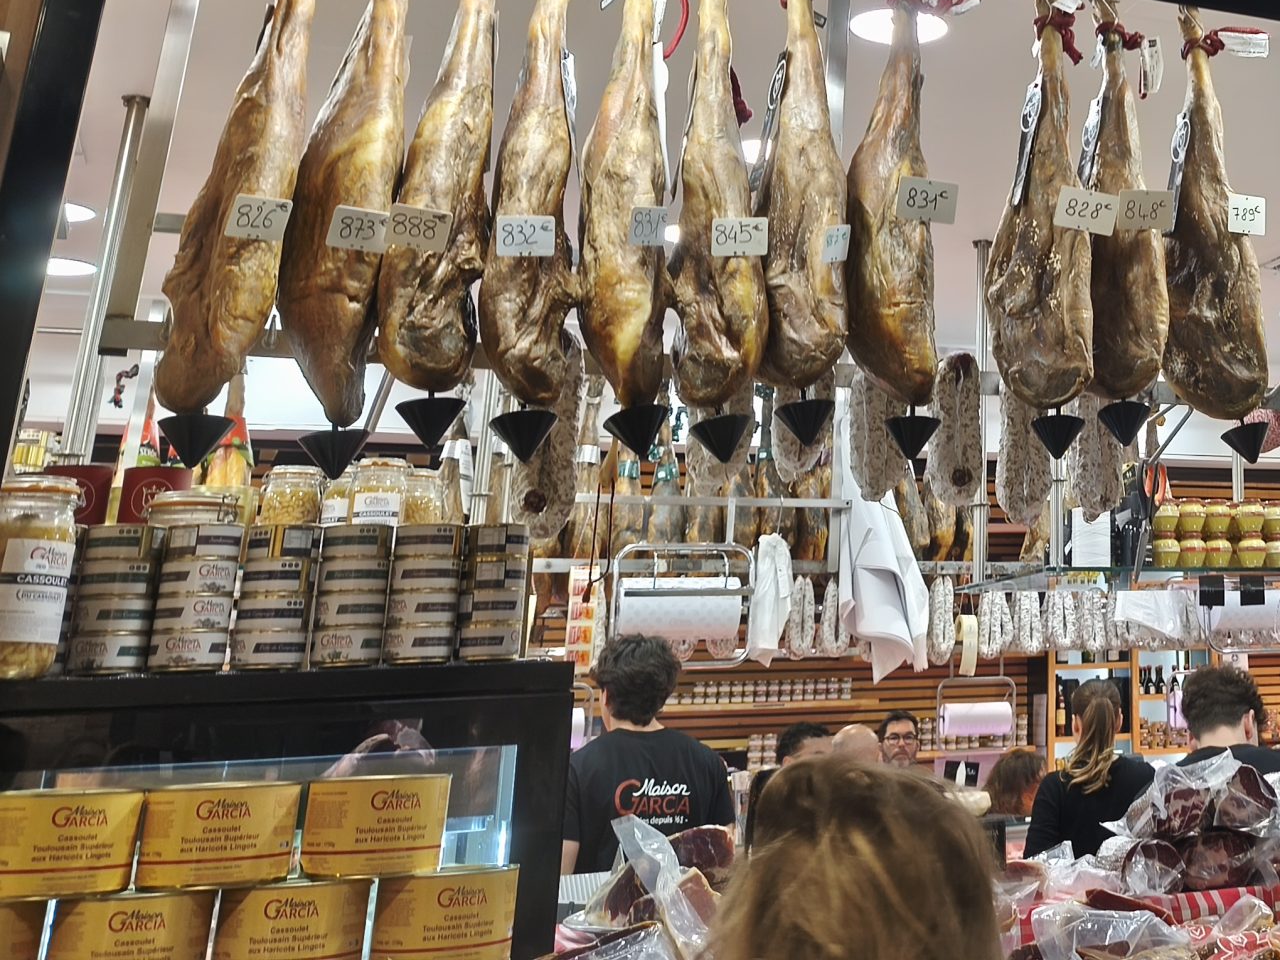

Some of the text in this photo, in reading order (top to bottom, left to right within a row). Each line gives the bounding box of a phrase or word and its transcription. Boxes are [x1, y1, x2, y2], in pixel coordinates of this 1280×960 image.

[16, 574, 68, 586] CASSOULET
[632, 778, 690, 796] Maison
[371, 790, 421, 811] GARCIA
[52, 806, 108, 828] GARCIA
[196, 800, 251, 820] GARCIA
[377, 816, 413, 824] Cassoulet
[650, 815, 673, 825] depuis
[203, 825, 241, 834] Cassoulet
[58, 834, 98, 842] Cassoulet
[437, 887, 488, 908] GARCIA
[264, 899, 319, 920] GARCIA
[271, 925, 309, 934] Cassoulet
